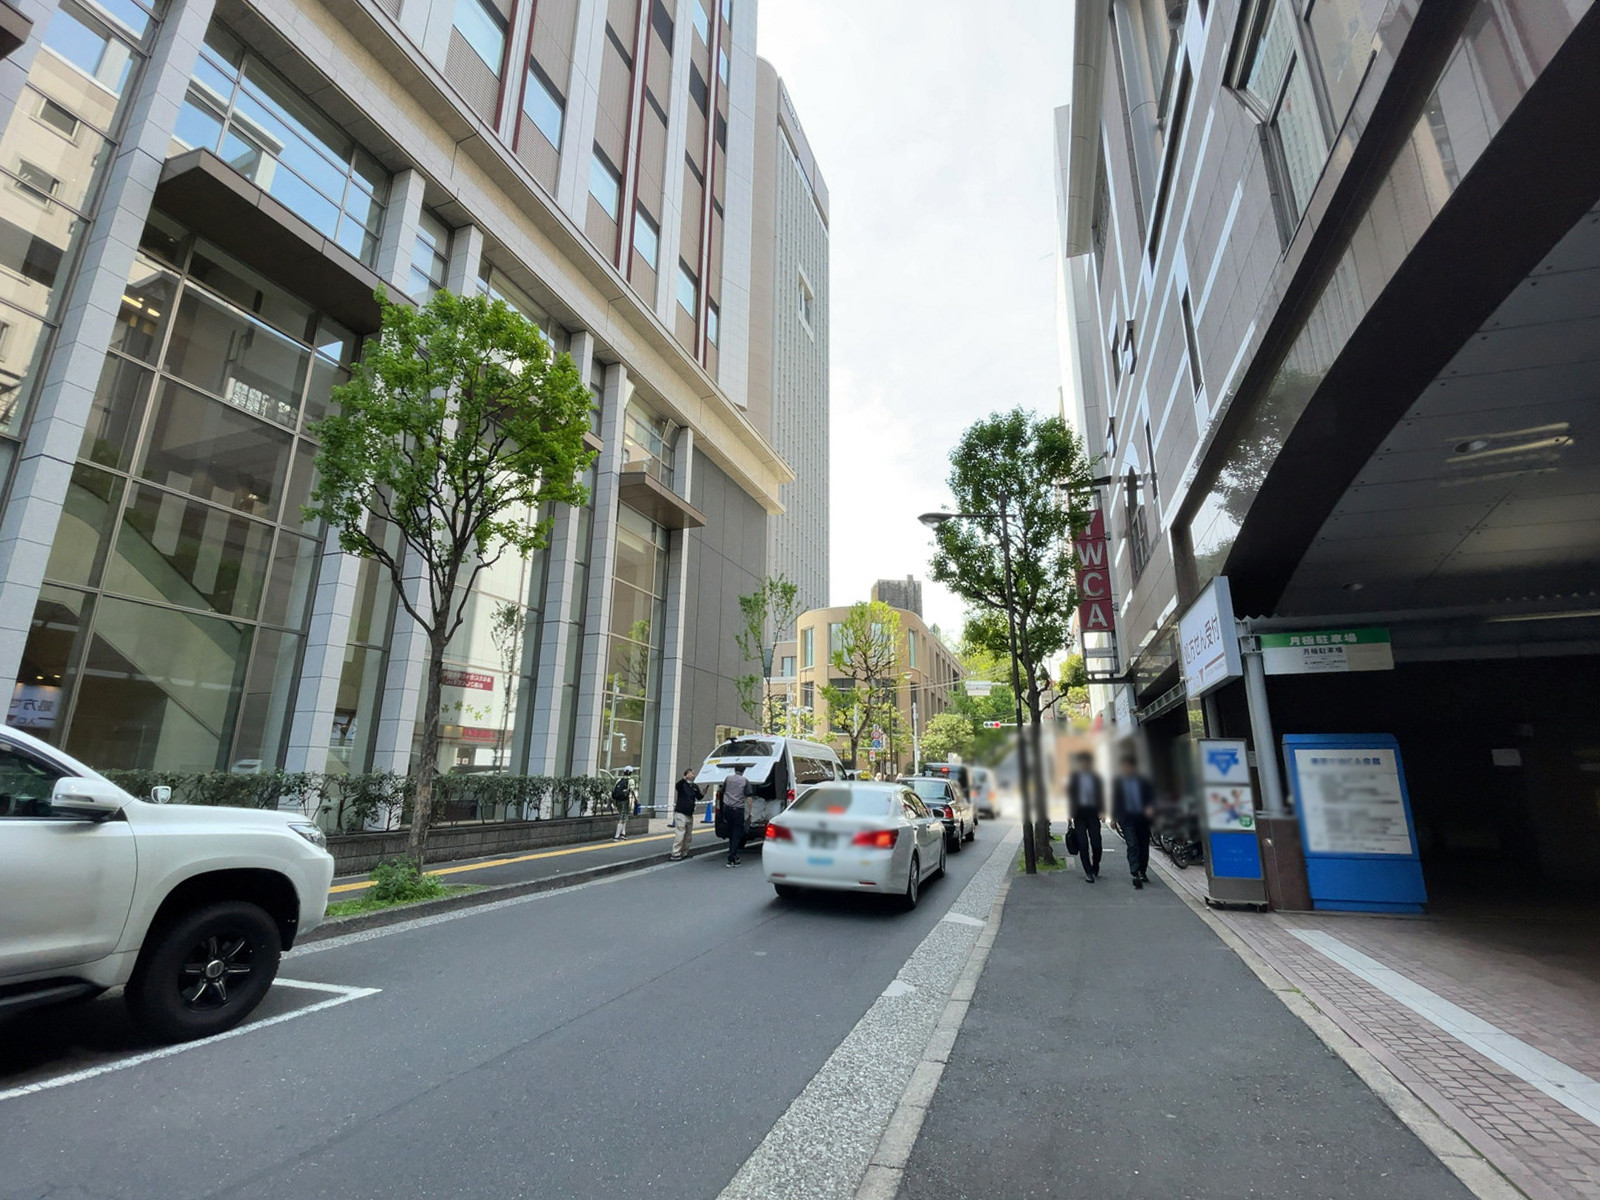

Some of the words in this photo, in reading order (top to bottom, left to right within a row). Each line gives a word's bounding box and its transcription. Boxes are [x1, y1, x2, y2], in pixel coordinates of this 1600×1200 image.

[1289, 632, 1358, 646] 月極駐車場
[1303, 645, 1344, 655] 月極駐車場
